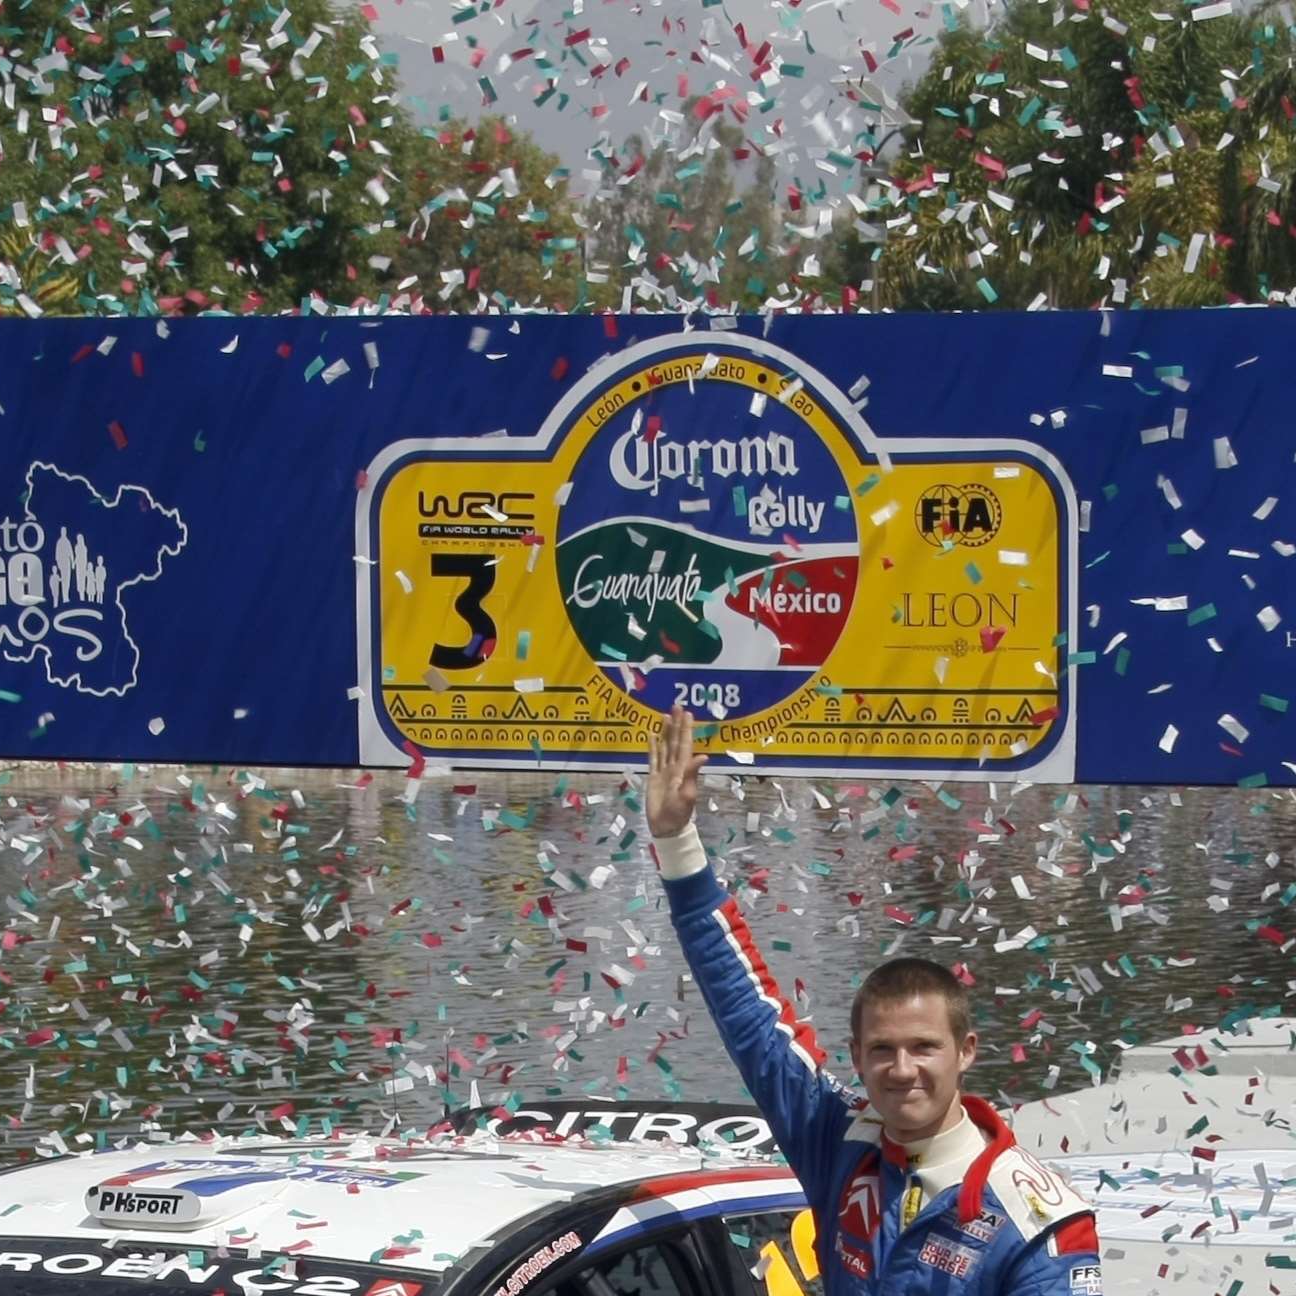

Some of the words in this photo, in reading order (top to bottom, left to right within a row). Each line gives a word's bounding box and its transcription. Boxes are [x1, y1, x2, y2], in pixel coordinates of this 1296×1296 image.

[586, 393, 625, 428] León
[650, 362, 746, 386] Guanauato
[610, 431, 800, 496] Corona
[418, 491, 535, 520] WRC
[748, 492, 825, 533] Rally
[922, 498, 993, 533] FIA
[444, 526, 488, 534] WORLD
[490, 527, 535, 536] RALLY
[566, 553, 702, 622] Guanajuato
[748, 585, 841, 615] México
[429, 553, 497, 669] 3
[674, 683, 741, 707] 2008
[918, 1251, 965, 1278] CORSE
[926, 1241, 953, 1260] TOUR
